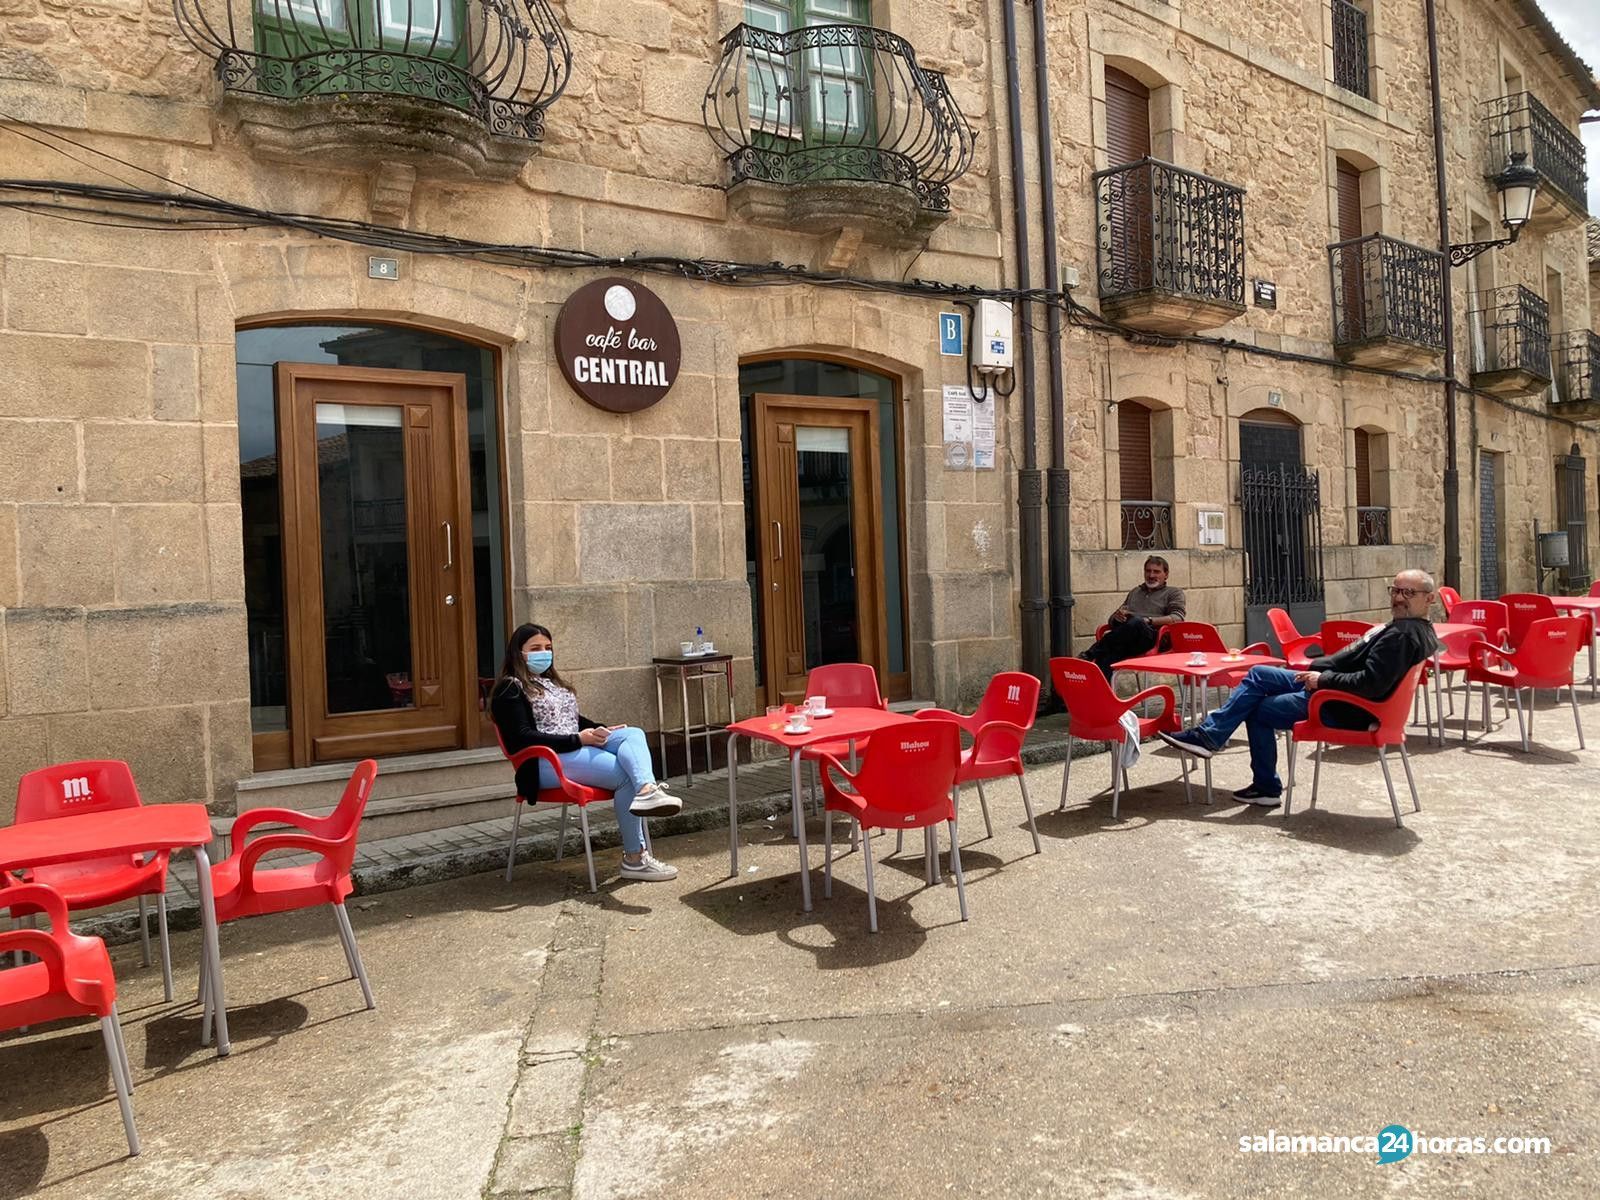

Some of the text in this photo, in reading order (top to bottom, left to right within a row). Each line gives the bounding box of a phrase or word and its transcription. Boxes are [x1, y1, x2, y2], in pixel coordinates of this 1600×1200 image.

[380, 263, 388, 273] 8
[585, 326, 658, 353] café bar
[946, 318, 956, 340] B
[574, 356, 669, 386] CENTRAL
[900, 741, 930, 750] Mahou
